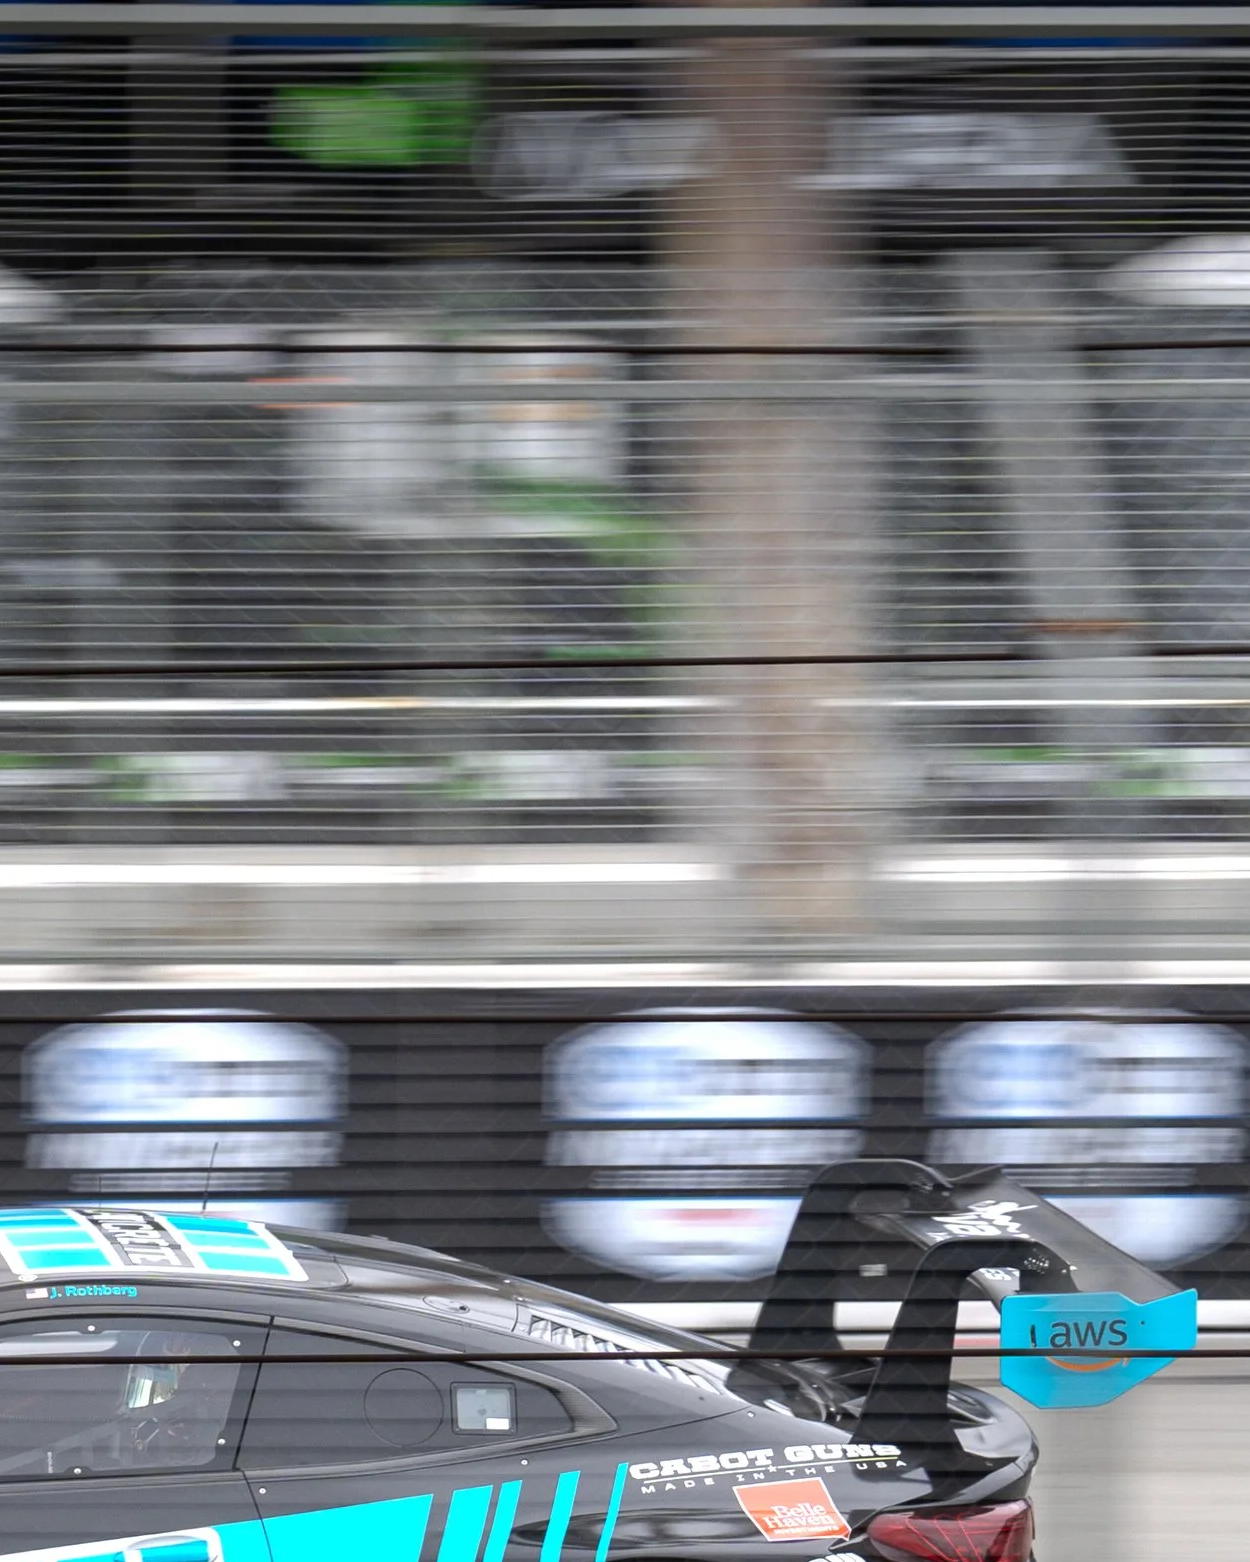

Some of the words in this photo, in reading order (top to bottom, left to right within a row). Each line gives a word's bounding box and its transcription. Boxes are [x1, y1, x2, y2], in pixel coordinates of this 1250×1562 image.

[1050, 1319, 1127, 1348] aws
[629, 1449, 774, 1479] CABOT
[784, 1444, 901, 1462] GUNS
[641, 1478, 715, 1494] MADE
[737, 1472, 765, 1482] IN
[786, 1465, 836, 1477] THE
[856, 1459, 907, 1471] USA
[762, 1515, 836, 1528] Haven
[771, 1503, 827, 1518] Belle
